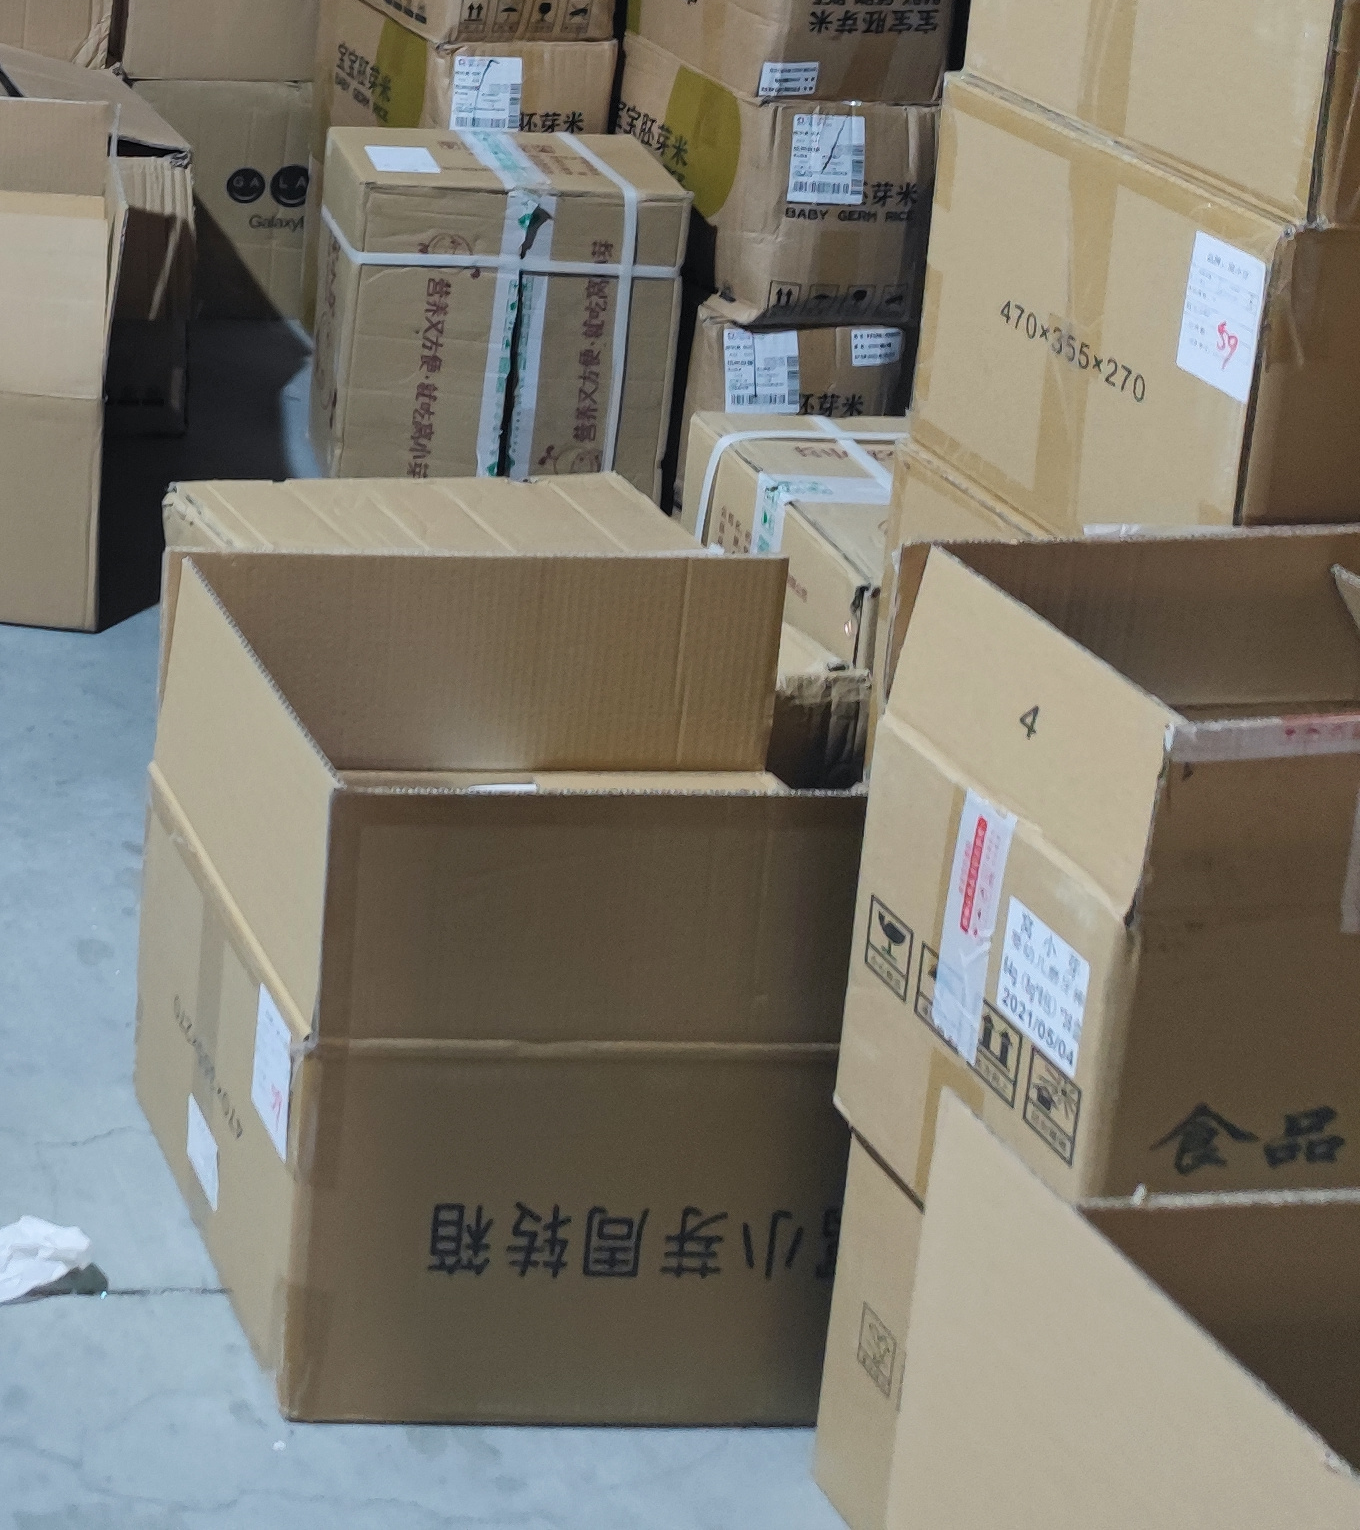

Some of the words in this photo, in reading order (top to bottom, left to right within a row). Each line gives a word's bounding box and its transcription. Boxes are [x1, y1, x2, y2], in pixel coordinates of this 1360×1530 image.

[809, 9, 939, 35] 宝宝胚芽米
[785, 207, 829, 221] BABY
[838, 208, 877, 222] GERM
[886, 209, 915, 222] RICE
[1150, 1101, 1346, 1174] 食品
